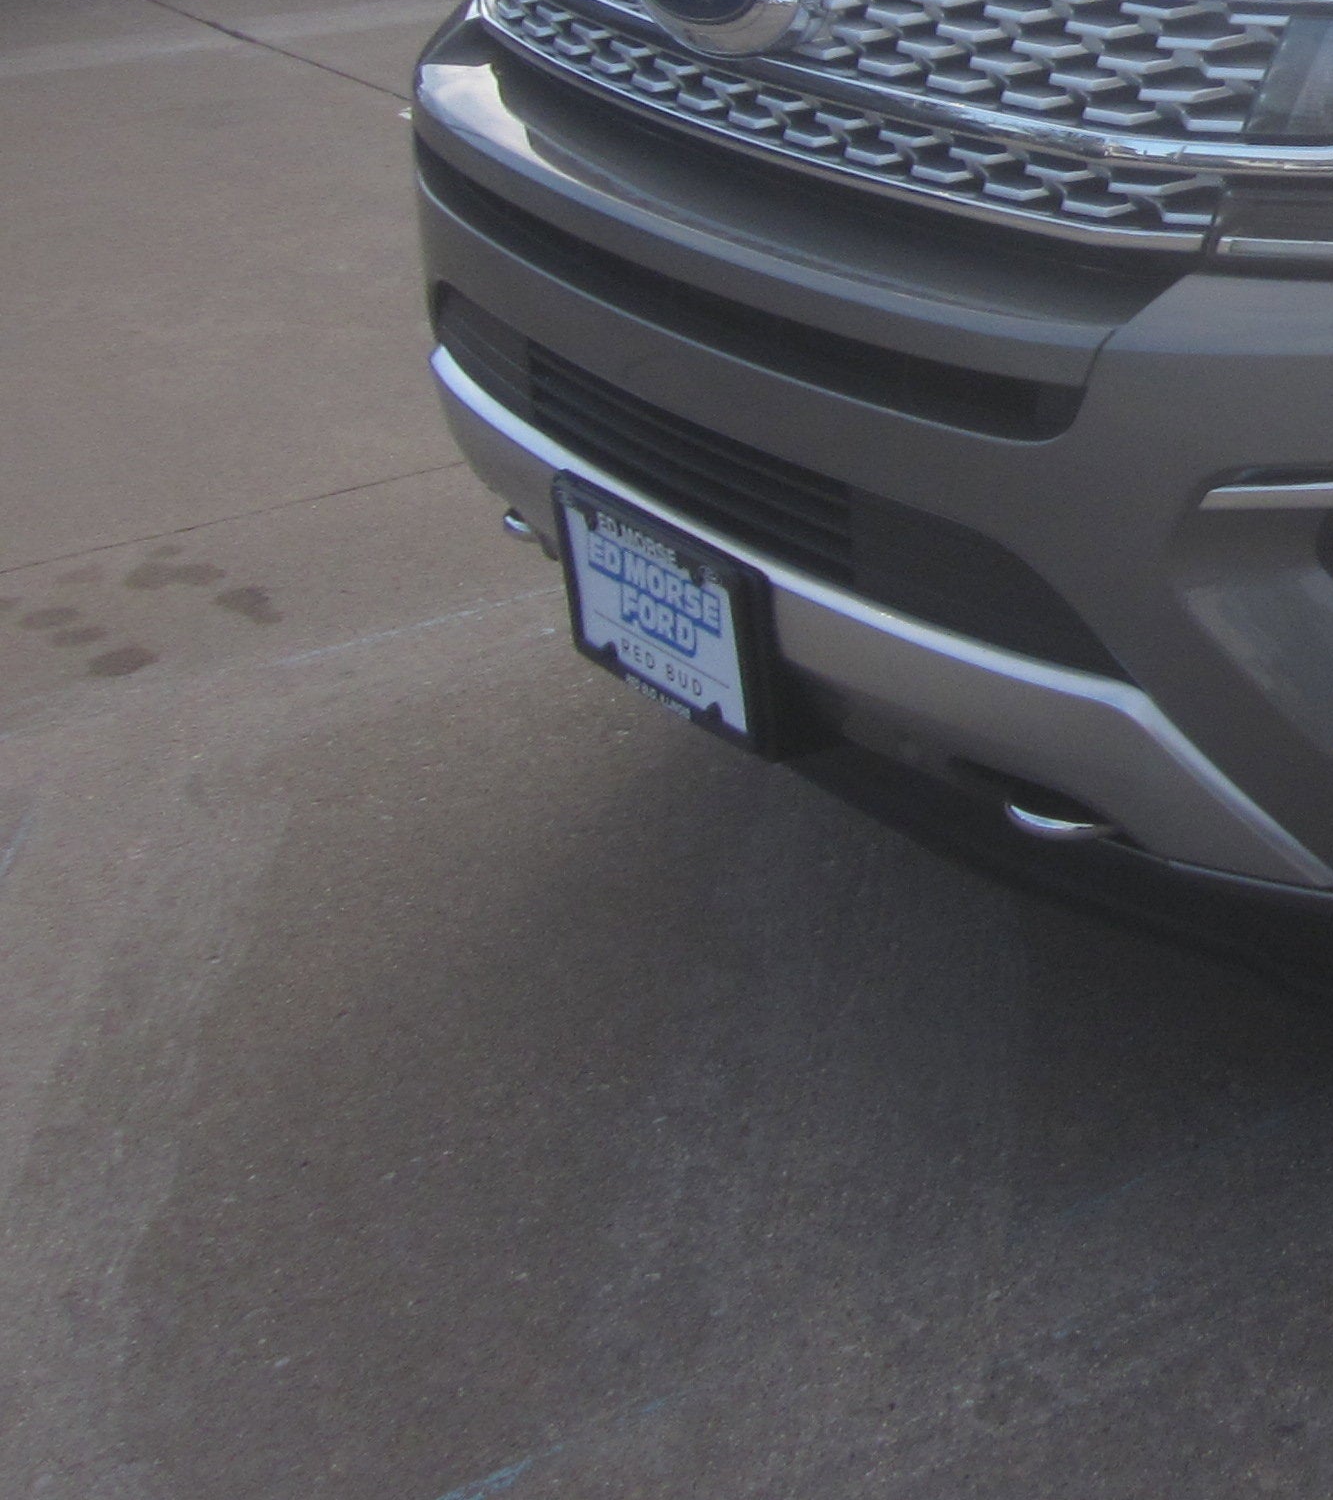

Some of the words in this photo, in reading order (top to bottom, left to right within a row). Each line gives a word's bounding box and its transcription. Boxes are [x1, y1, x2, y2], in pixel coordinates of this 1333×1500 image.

[588, 533, 622, 578] ED
[622, 547, 722, 637] MORSE
[621, 585, 698, 658] FORD
[665, 663, 703, 697] BUD
